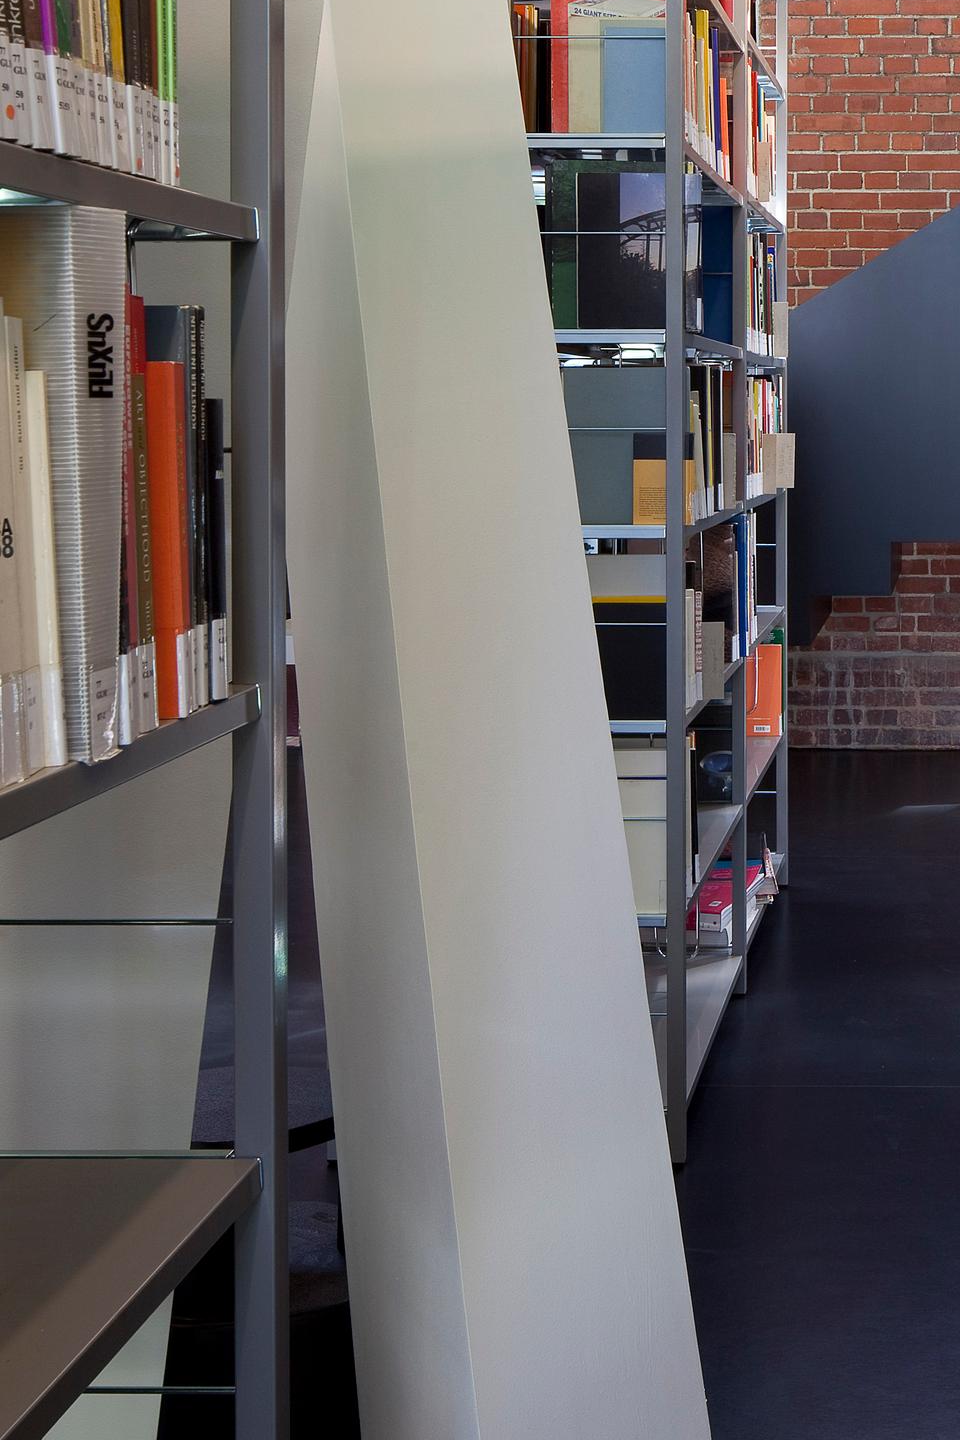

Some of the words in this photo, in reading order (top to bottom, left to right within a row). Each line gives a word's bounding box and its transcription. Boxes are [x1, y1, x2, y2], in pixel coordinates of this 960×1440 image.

[573, 6, 583, 15] 24
[583, 8, 602, 18] GIANT
[86, 312, 114, 399] FLUXUS
[135, 390, 144, 424] ART
[138, 453, 151, 583] OBJECTHOOD
